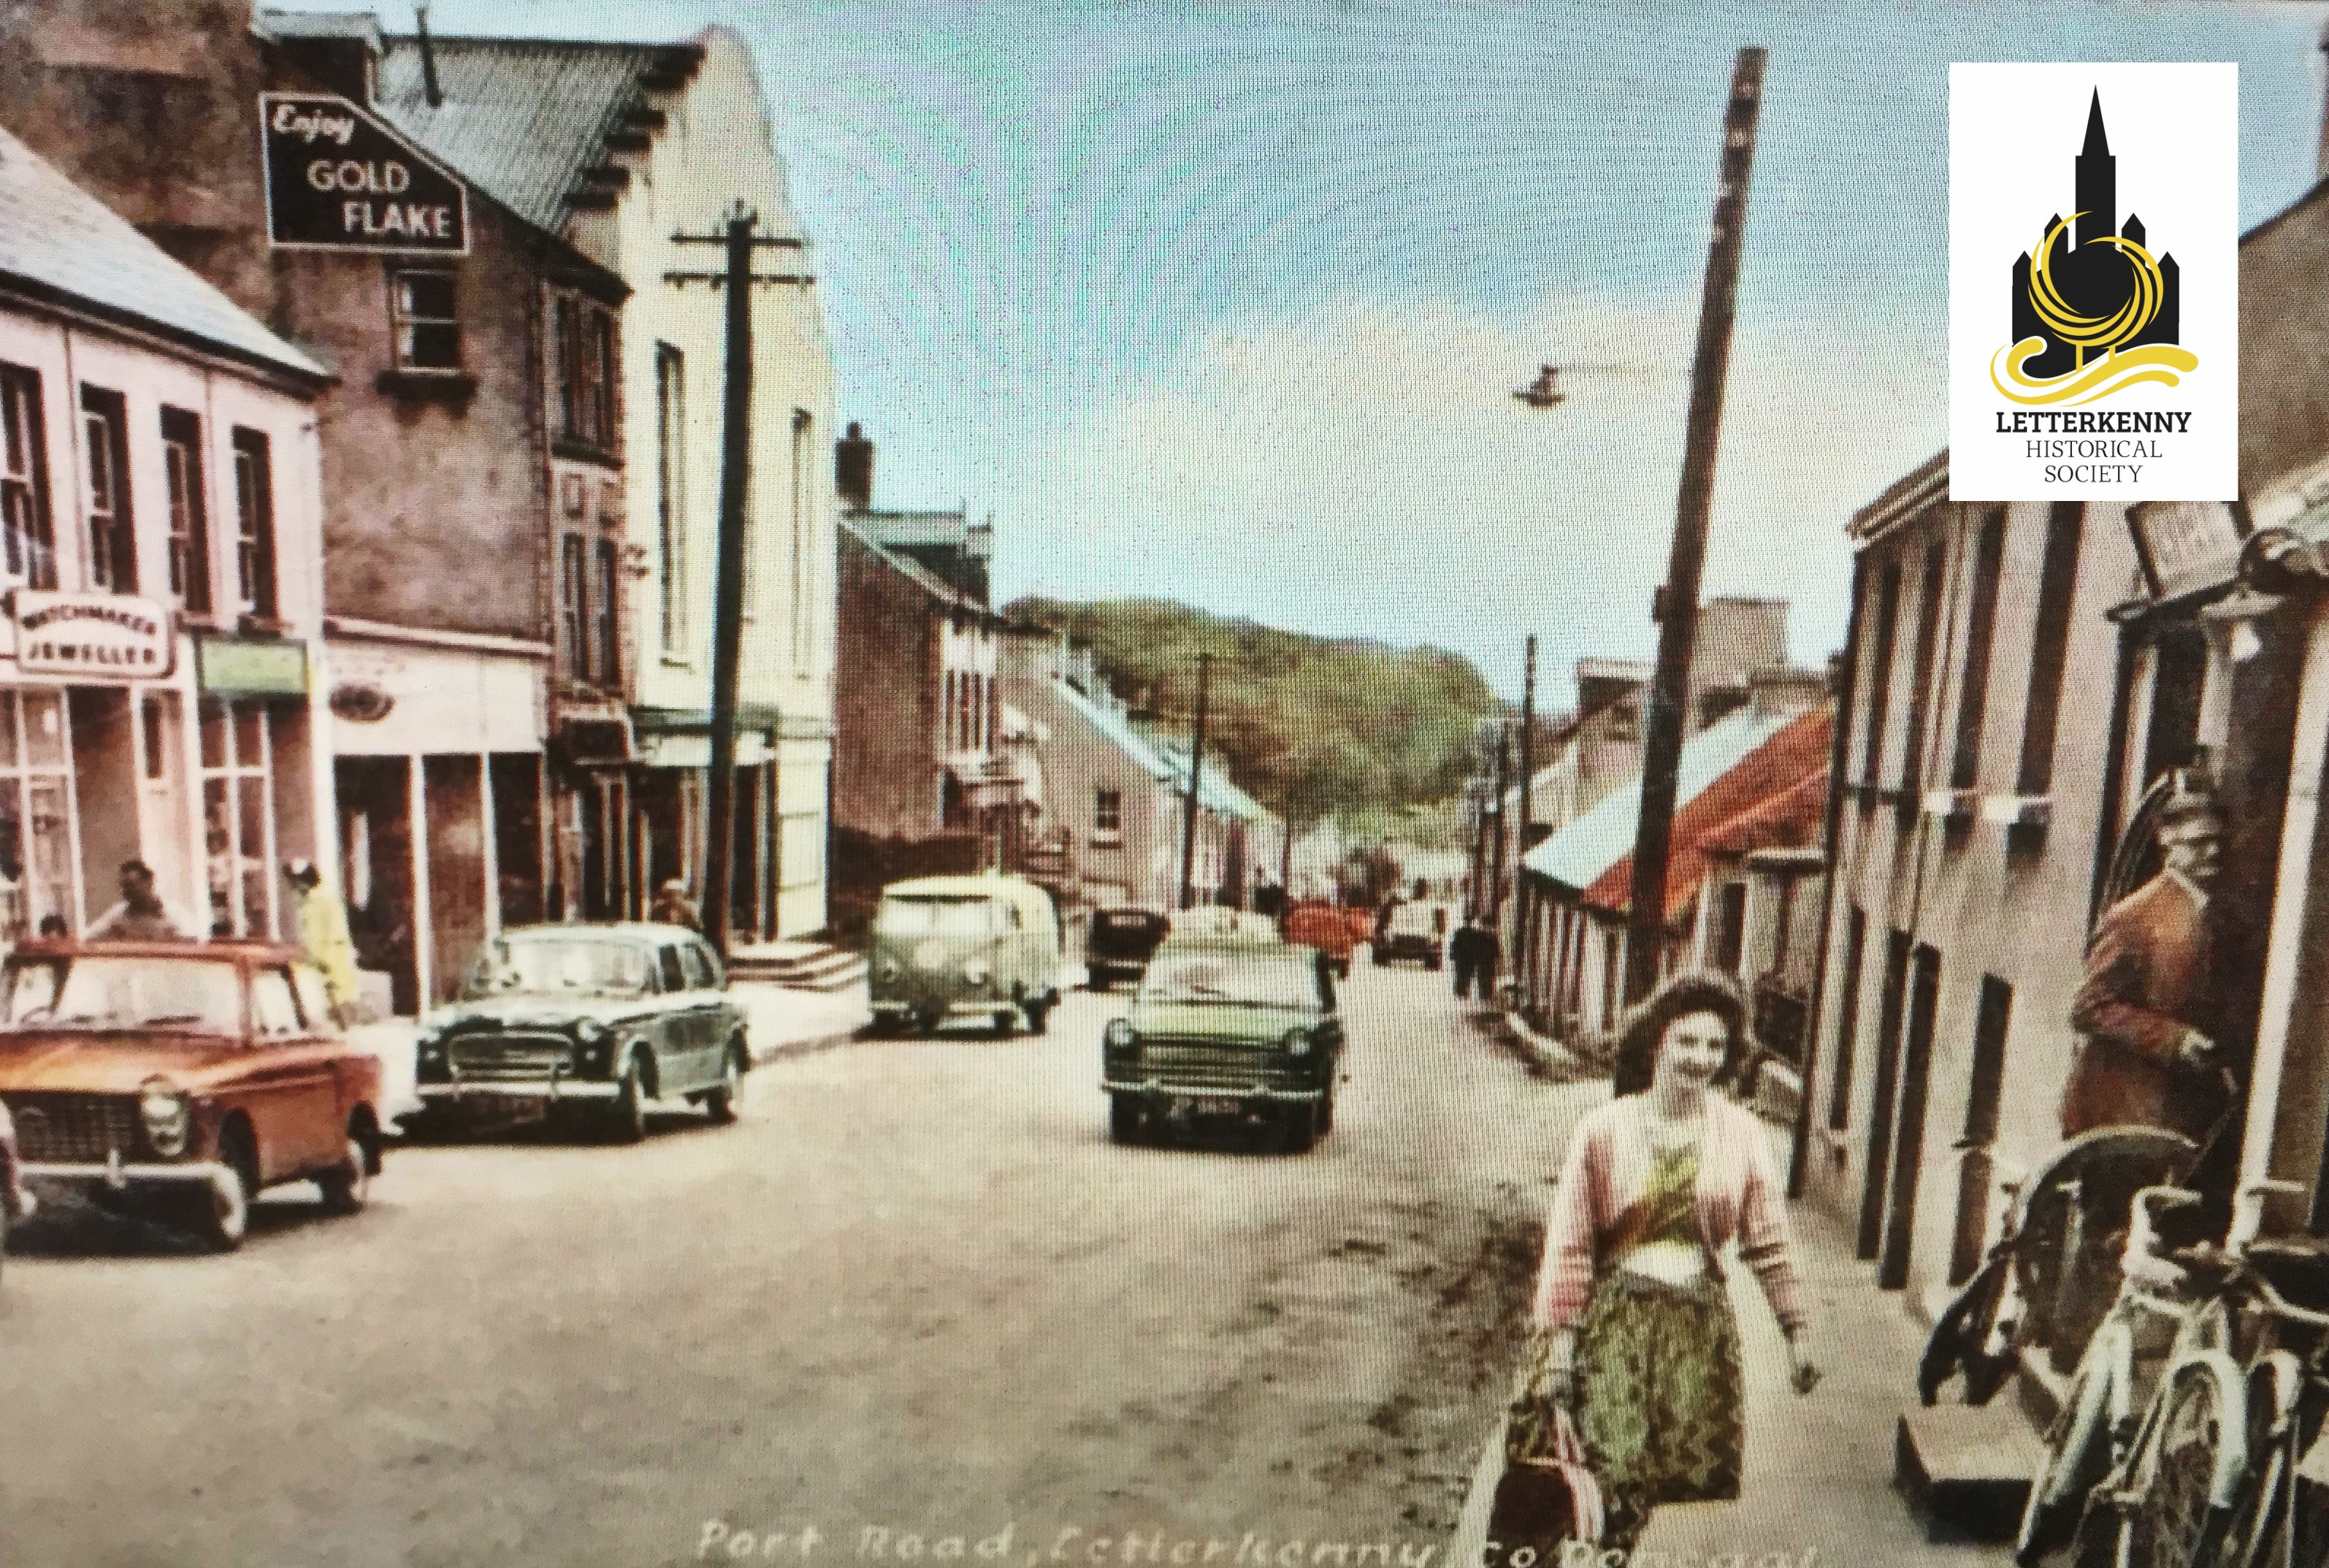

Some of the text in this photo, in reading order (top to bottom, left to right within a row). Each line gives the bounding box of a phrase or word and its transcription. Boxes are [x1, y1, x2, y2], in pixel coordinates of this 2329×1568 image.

[273, 104, 354, 145] Enjoy
[307, 159, 410, 194] GOLD
[343, 201, 451, 239] FLAKE
